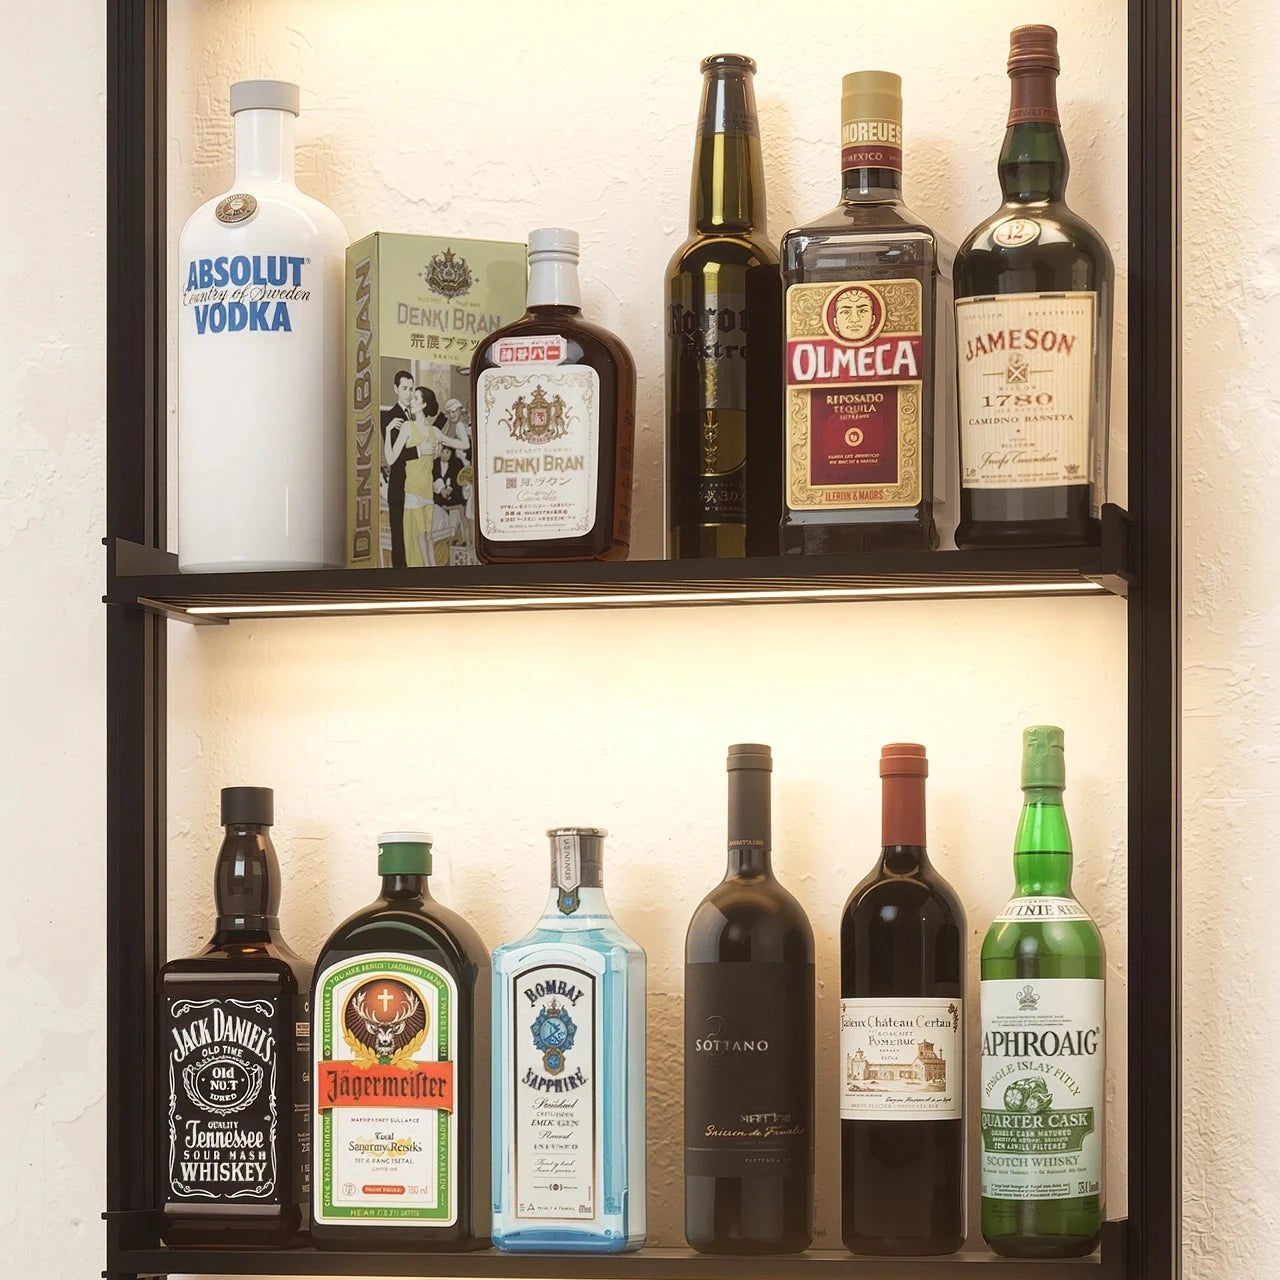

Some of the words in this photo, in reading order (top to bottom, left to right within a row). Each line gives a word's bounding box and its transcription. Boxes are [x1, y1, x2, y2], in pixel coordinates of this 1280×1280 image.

[187, 256, 305, 291] ABSOLUT
[250, 283, 311, 301] Sweden
[194, 301, 292, 335] VODKA
[397, 303, 448, 332] DENKI
[453, 308, 500, 335] BRAN
[966, 328, 1075, 361] JAMESON
[793, 341, 917, 380] OLMECA
[834, 404, 876, 415] TEQUILA
[493, 455, 540, 474] DENKI
[544, 454, 584, 472] BRAN
[524, 979, 585, 1007] BOMBAY
[172, 1017, 211, 1062] JACK
[981, 1030, 1098, 1057] APHROAIG
[202, 1046, 219, 1057] OLD
[222, 1046, 244, 1057] TIME
[212, 1067, 235, 1078] Old
[1017, 1061, 1054, 1074] ISLAY
[521, 1066, 588, 1093] SAPPHIRE
[208, 1121, 239, 1129] QUALITY
[982, 1114, 1044, 1130] QUARTER
[1048, 1113, 1088, 1128] CASK
[185, 1120, 264, 1148] Tennessee
[183, 1150, 220, 1160] SOUR
[229, 1150, 267, 1160] MASH
[986, 1156, 1028, 1167] SCOTCH
[1031, 1154, 1080, 1167] WHISKY
[180, 1162, 268, 1182] WHISKEY
